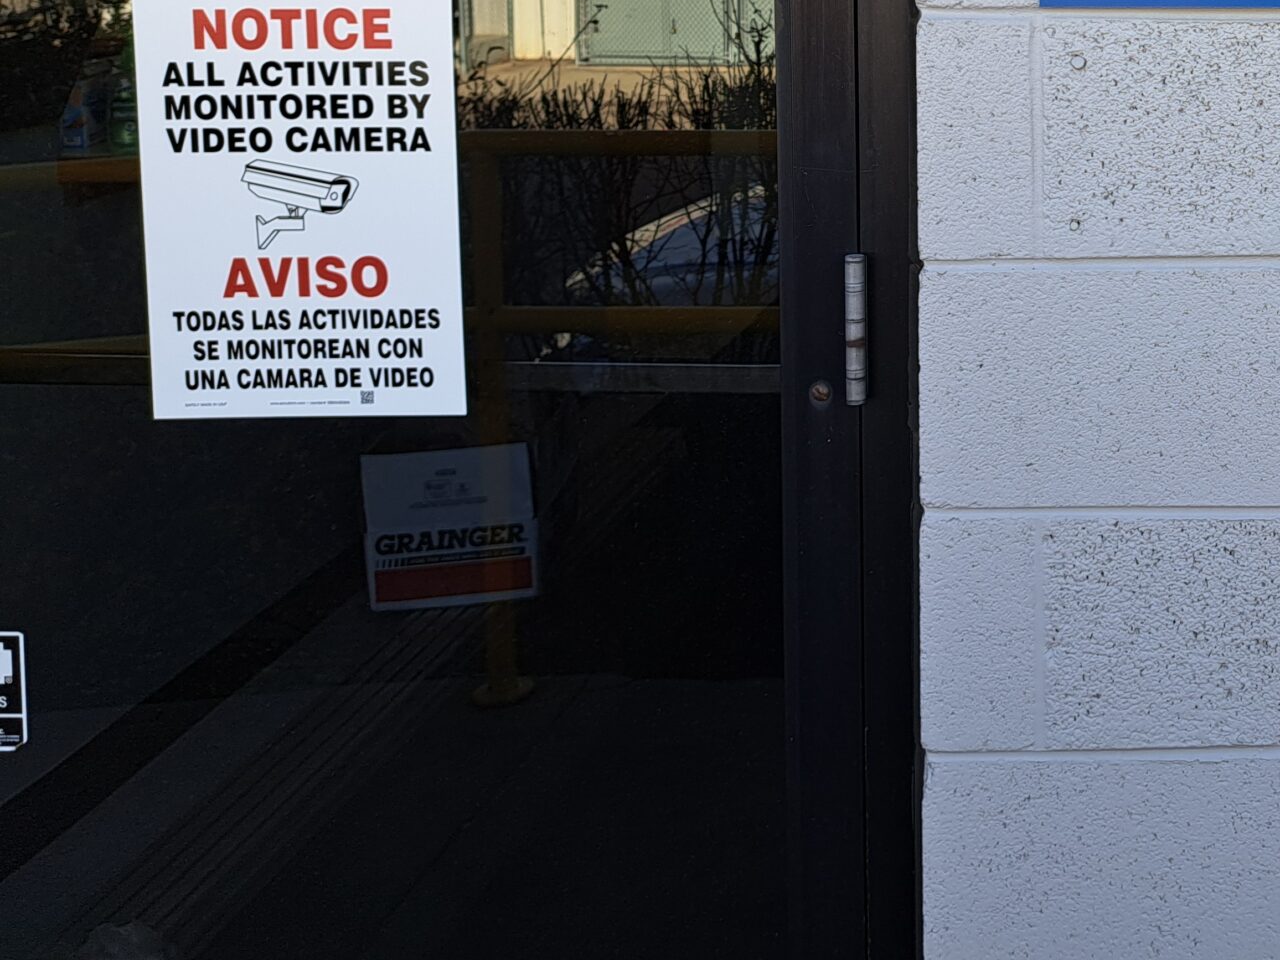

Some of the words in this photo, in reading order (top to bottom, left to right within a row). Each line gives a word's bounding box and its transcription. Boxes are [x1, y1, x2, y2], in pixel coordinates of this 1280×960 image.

[193, 8, 392, 50] NOTICE
[163, 62, 224, 87] ALL
[237, 61, 428, 86] ACTIVITIES
[165, 94, 373, 120] MONITORED
[388, 94, 430, 119] BY
[166, 127, 272, 153] VIDEO
[286, 127, 431, 152] CAMERA
[224, 256, 388, 298] AVISO
[173, 310, 244, 331] TODAS
[252, 310, 291, 330] LAS
[299, 309, 440, 330] ACTIVIDADES
[193, 340, 219, 361] SE
[227, 339, 369, 360] MONITOREAN
[378, 338, 422, 358] CON
[185, 370, 230, 390] UNA
[237, 368, 327, 389] CAMARA
[335, 368, 362, 387] DE
[369, 367, 434, 387] VIDEO
[375, 524, 524, 555] GRAINGER
